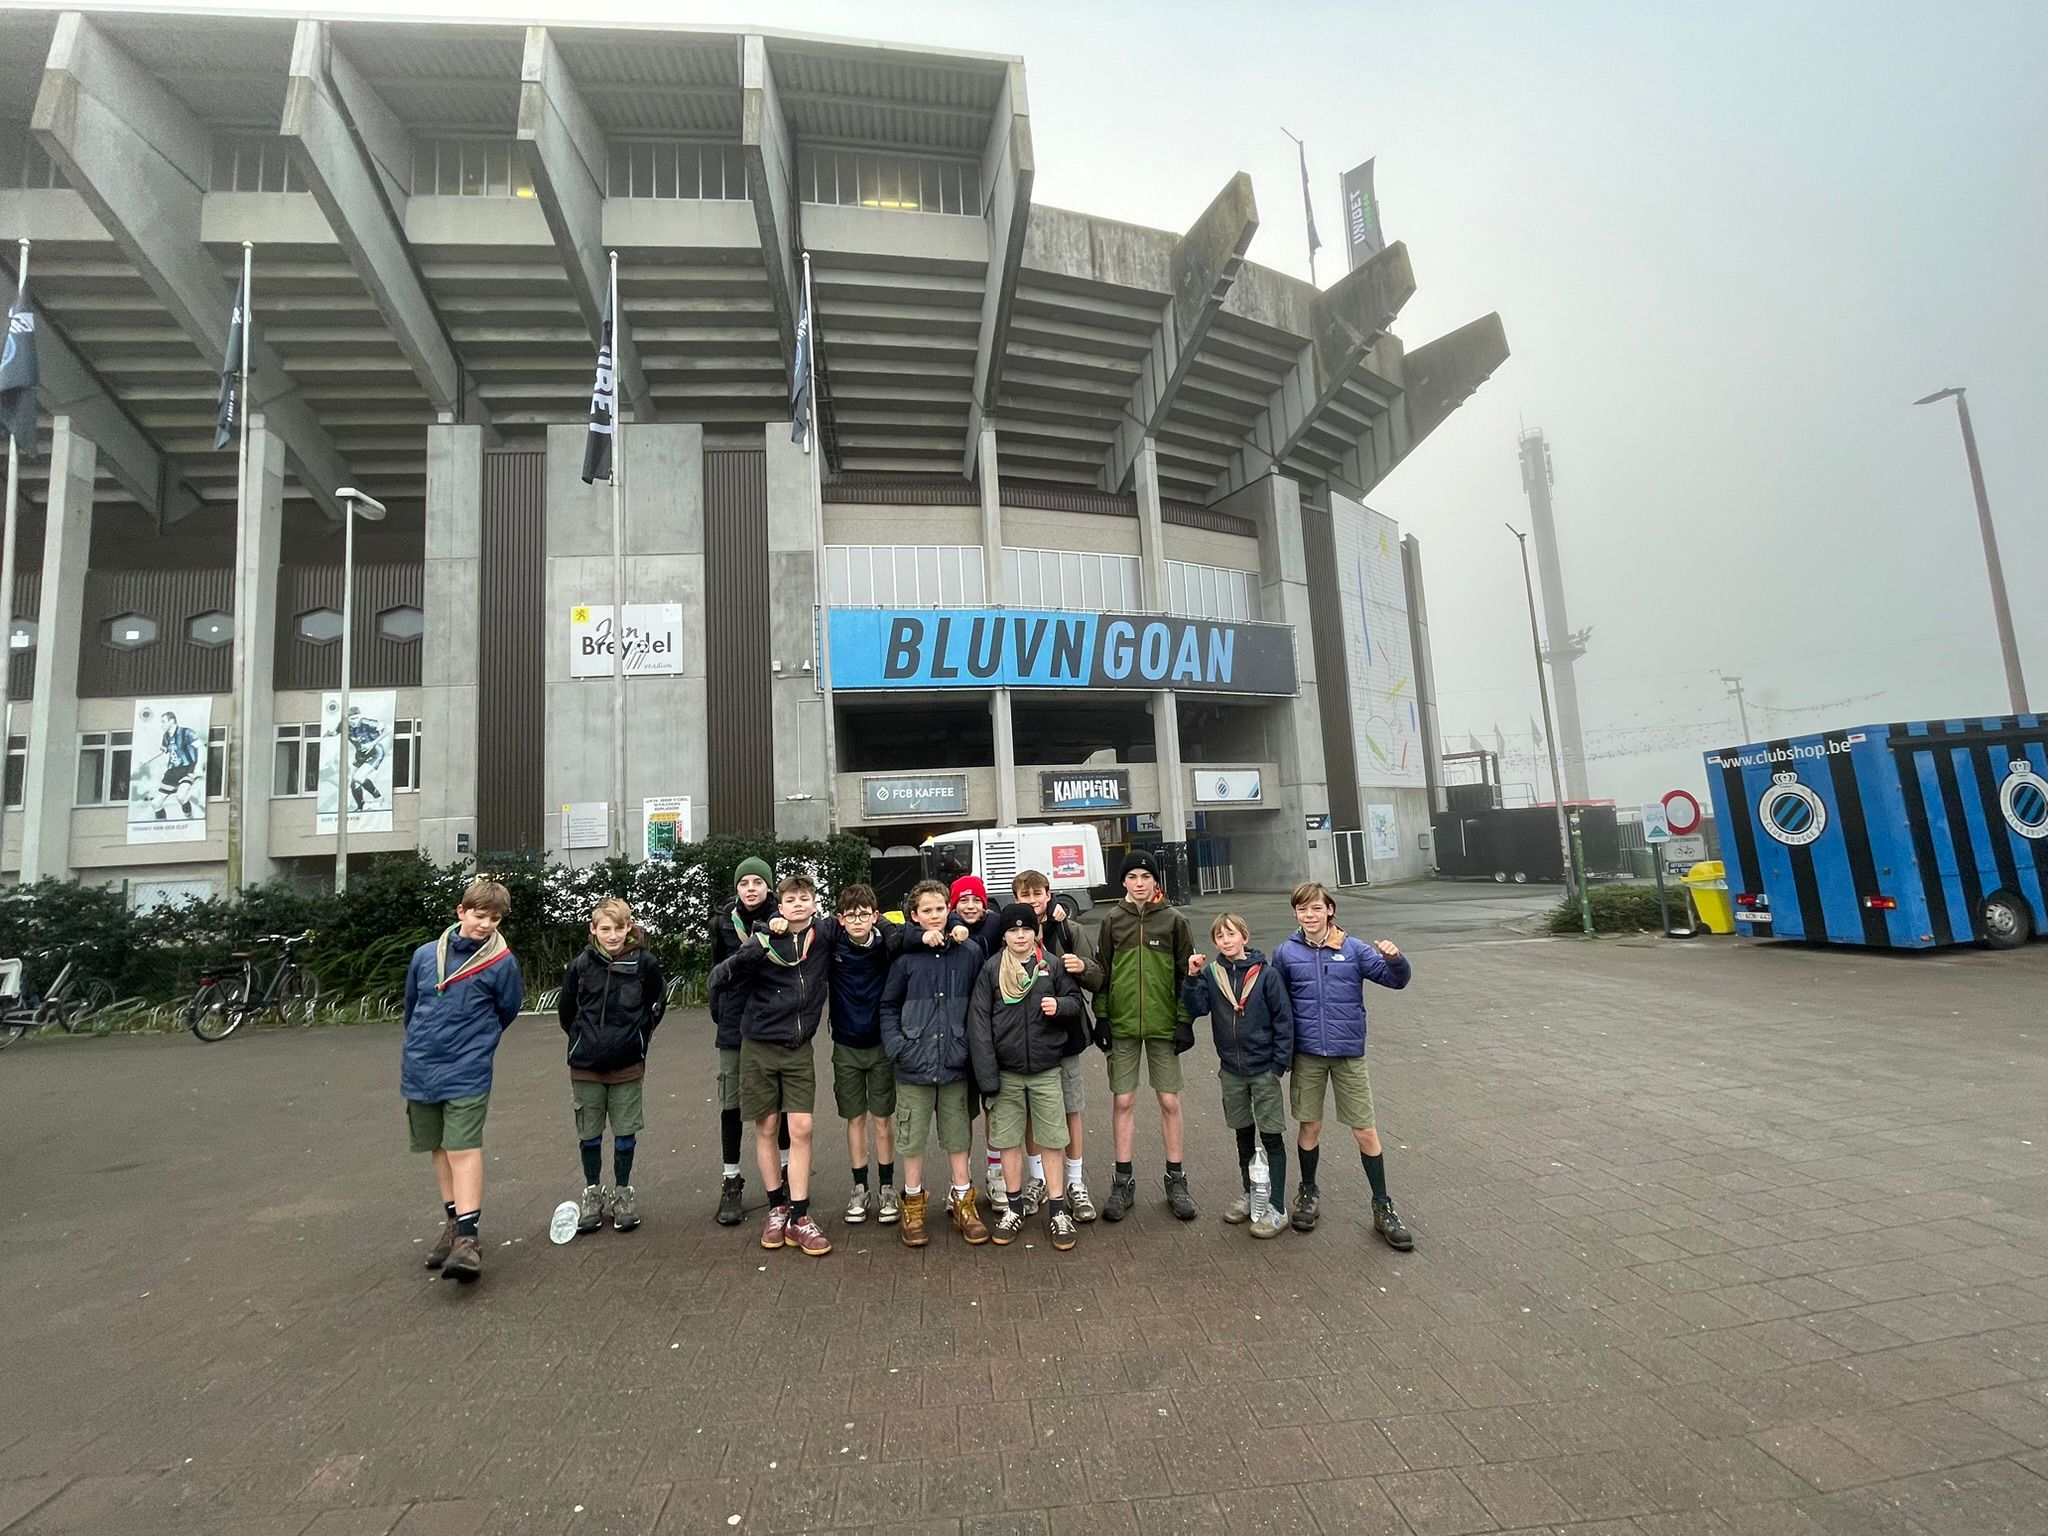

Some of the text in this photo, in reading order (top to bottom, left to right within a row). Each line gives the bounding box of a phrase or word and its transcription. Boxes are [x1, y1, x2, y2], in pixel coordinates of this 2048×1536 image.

[884, 617, 1235, 684] BLUVN GOAN
[1720, 740, 1852, 769] www.clubshop.be
[893, 787, 955, 798] FCB KAFFEE
